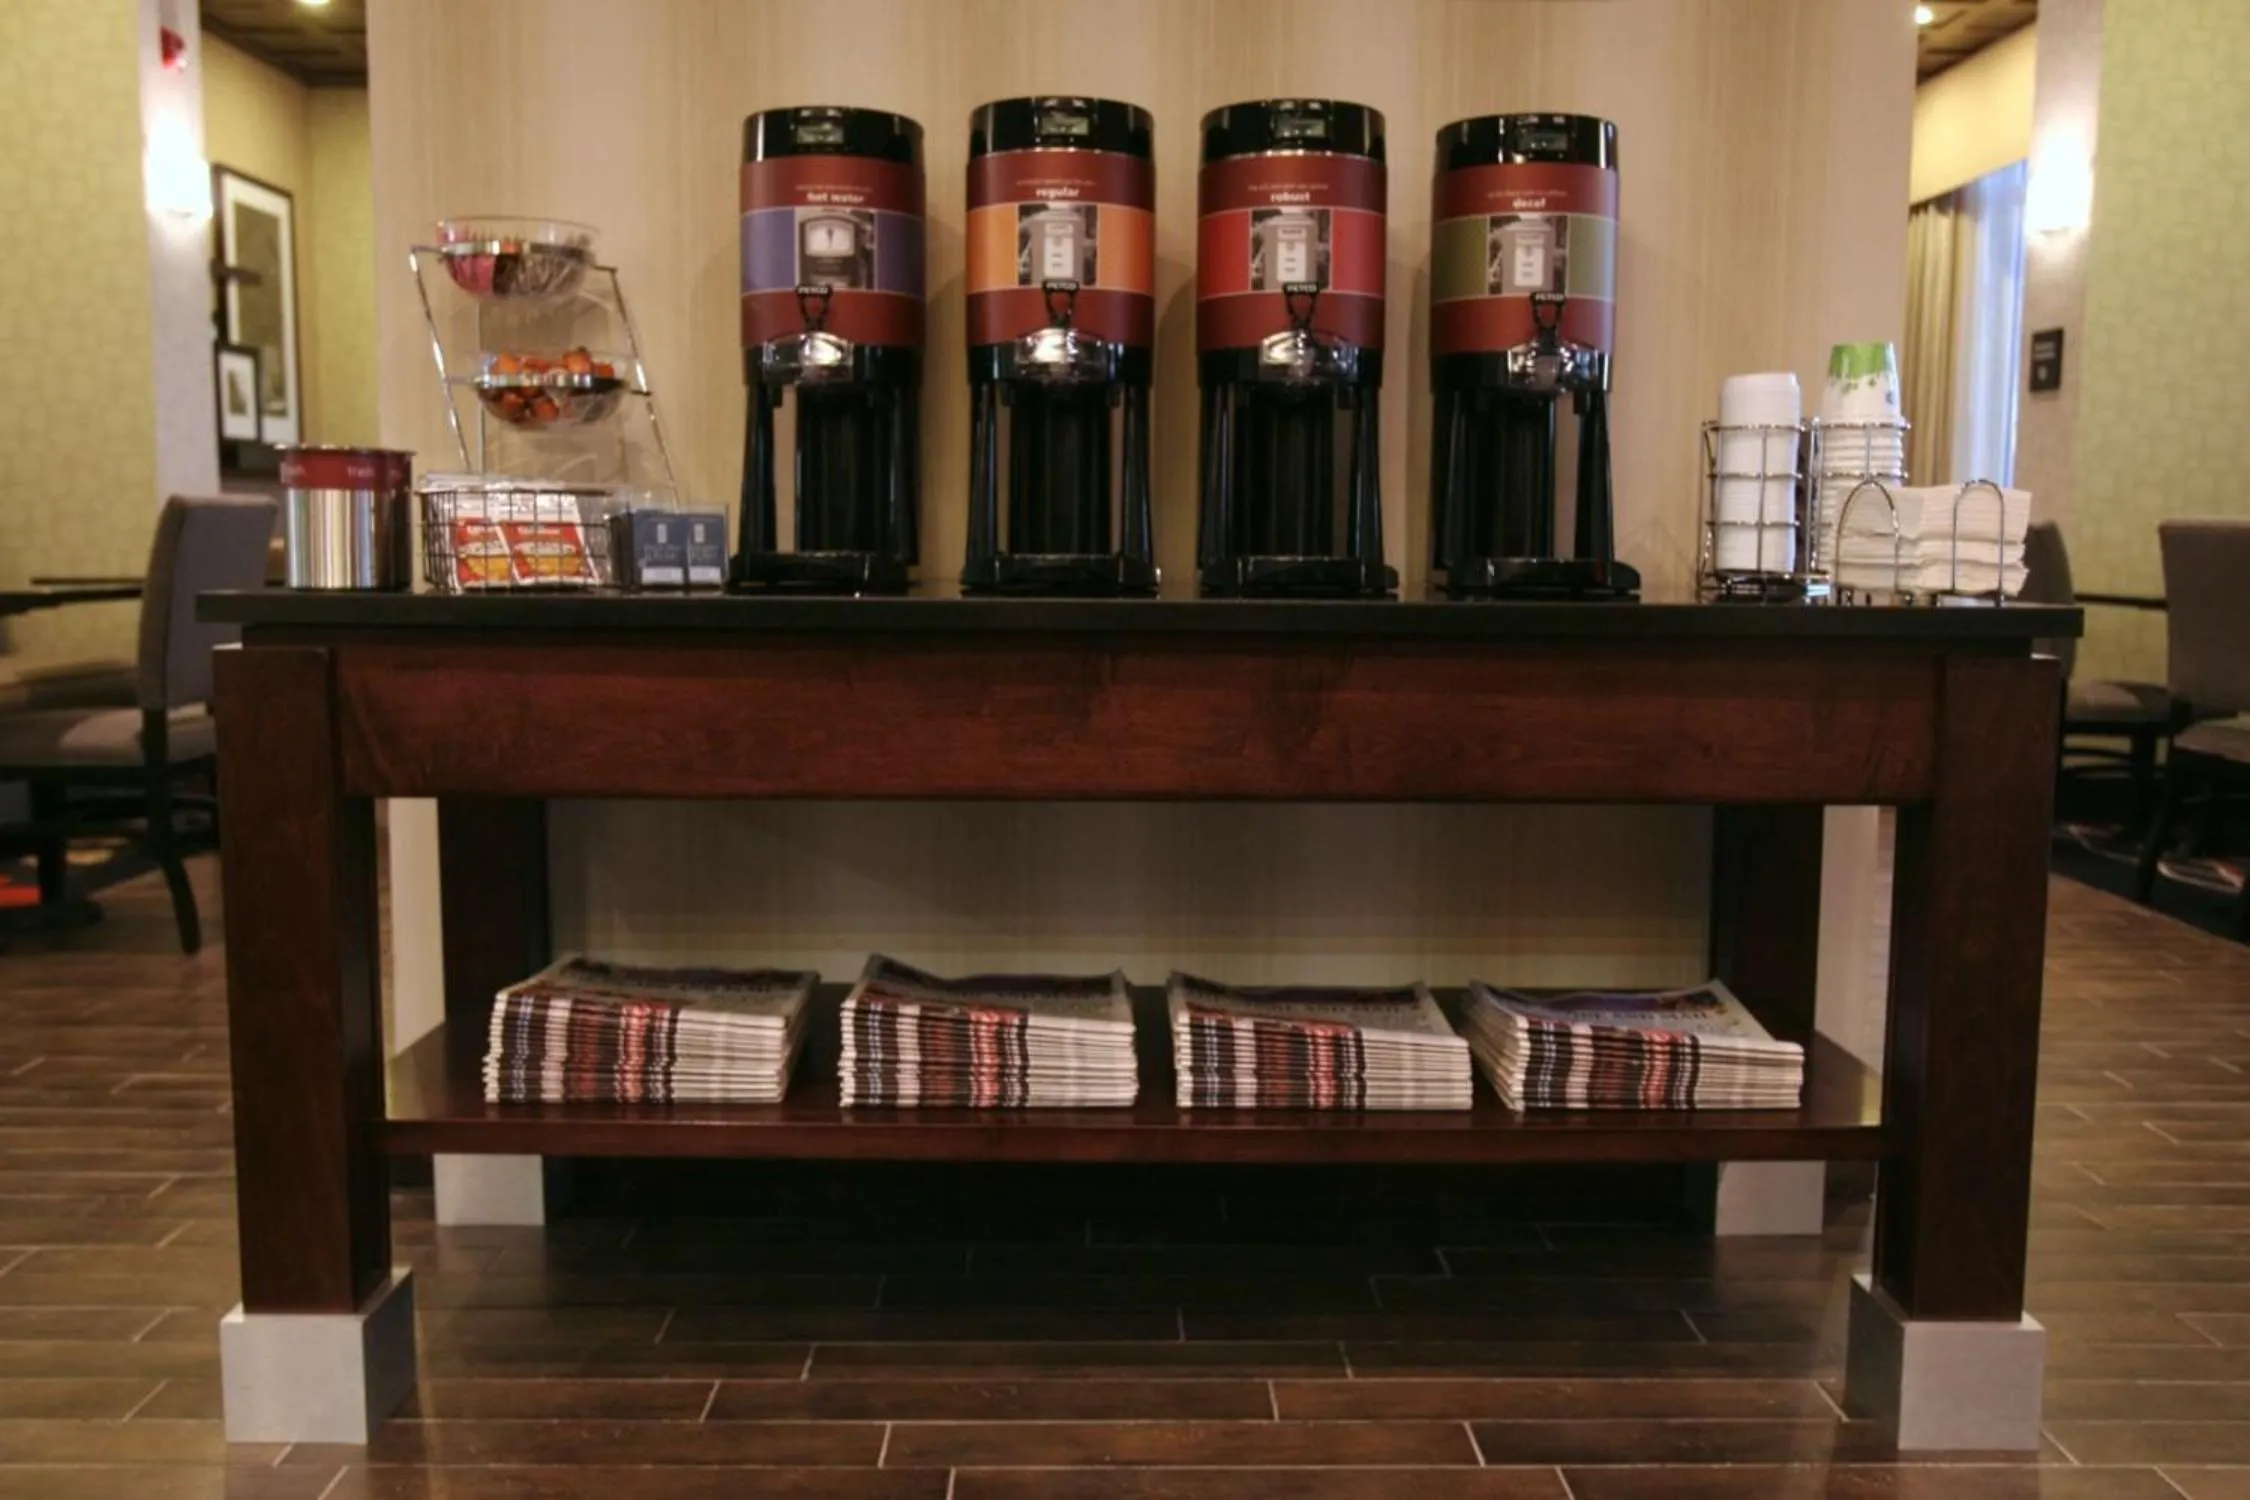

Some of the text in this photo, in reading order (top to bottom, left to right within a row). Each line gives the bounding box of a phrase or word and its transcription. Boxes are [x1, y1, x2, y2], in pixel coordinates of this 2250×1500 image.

[806, 192, 864, 203] hot water
[1035, 187, 1080, 199] regular
[1269, 192, 1311, 202] robust
[1511, 197, 1546, 209] decaf
